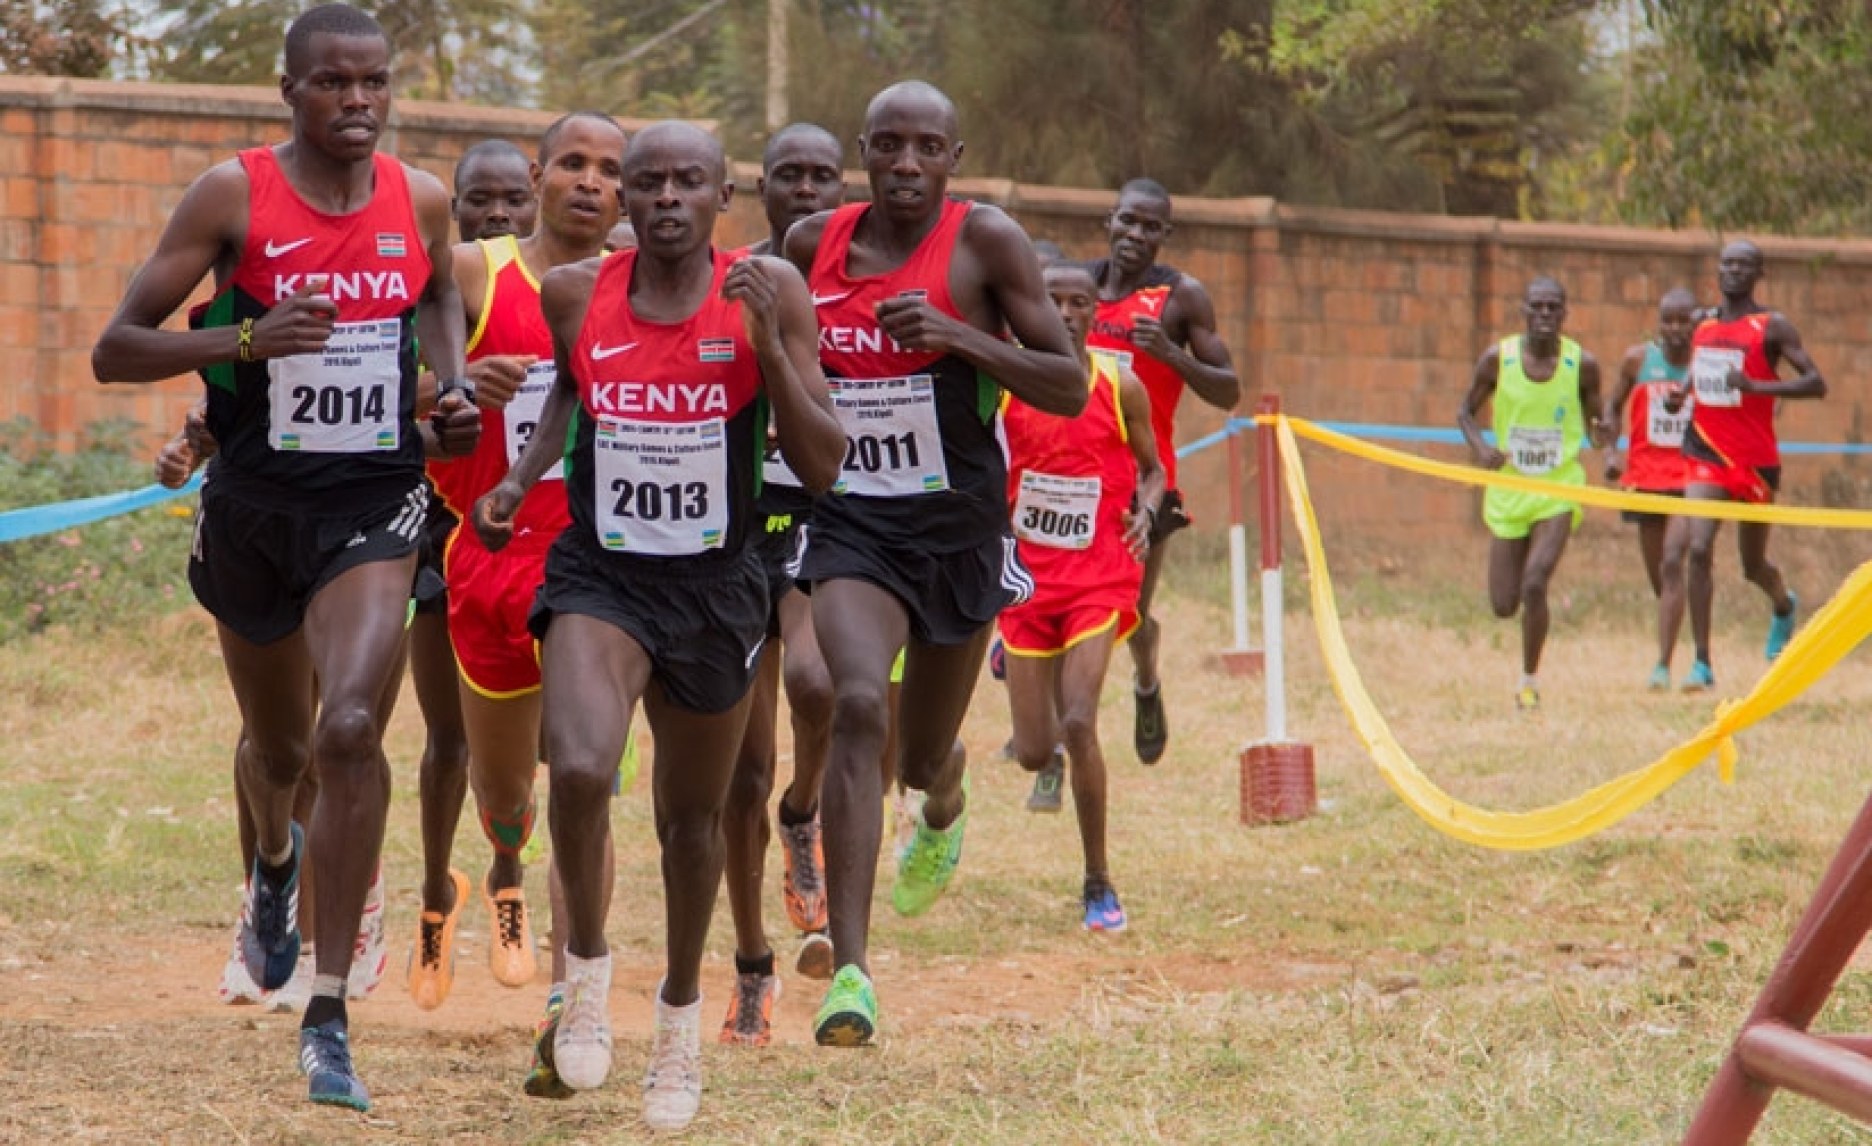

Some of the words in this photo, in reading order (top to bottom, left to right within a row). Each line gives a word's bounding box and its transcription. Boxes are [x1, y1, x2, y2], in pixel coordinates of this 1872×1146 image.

[274, 272, 409, 301] KENYA
[291, 384, 385, 425] 2014
[591, 381, 728, 412] KENYA
[843, 431, 920, 473] 2011
[611, 478, 708, 521] 2013
[1023, 506, 1089, 537] 3006
